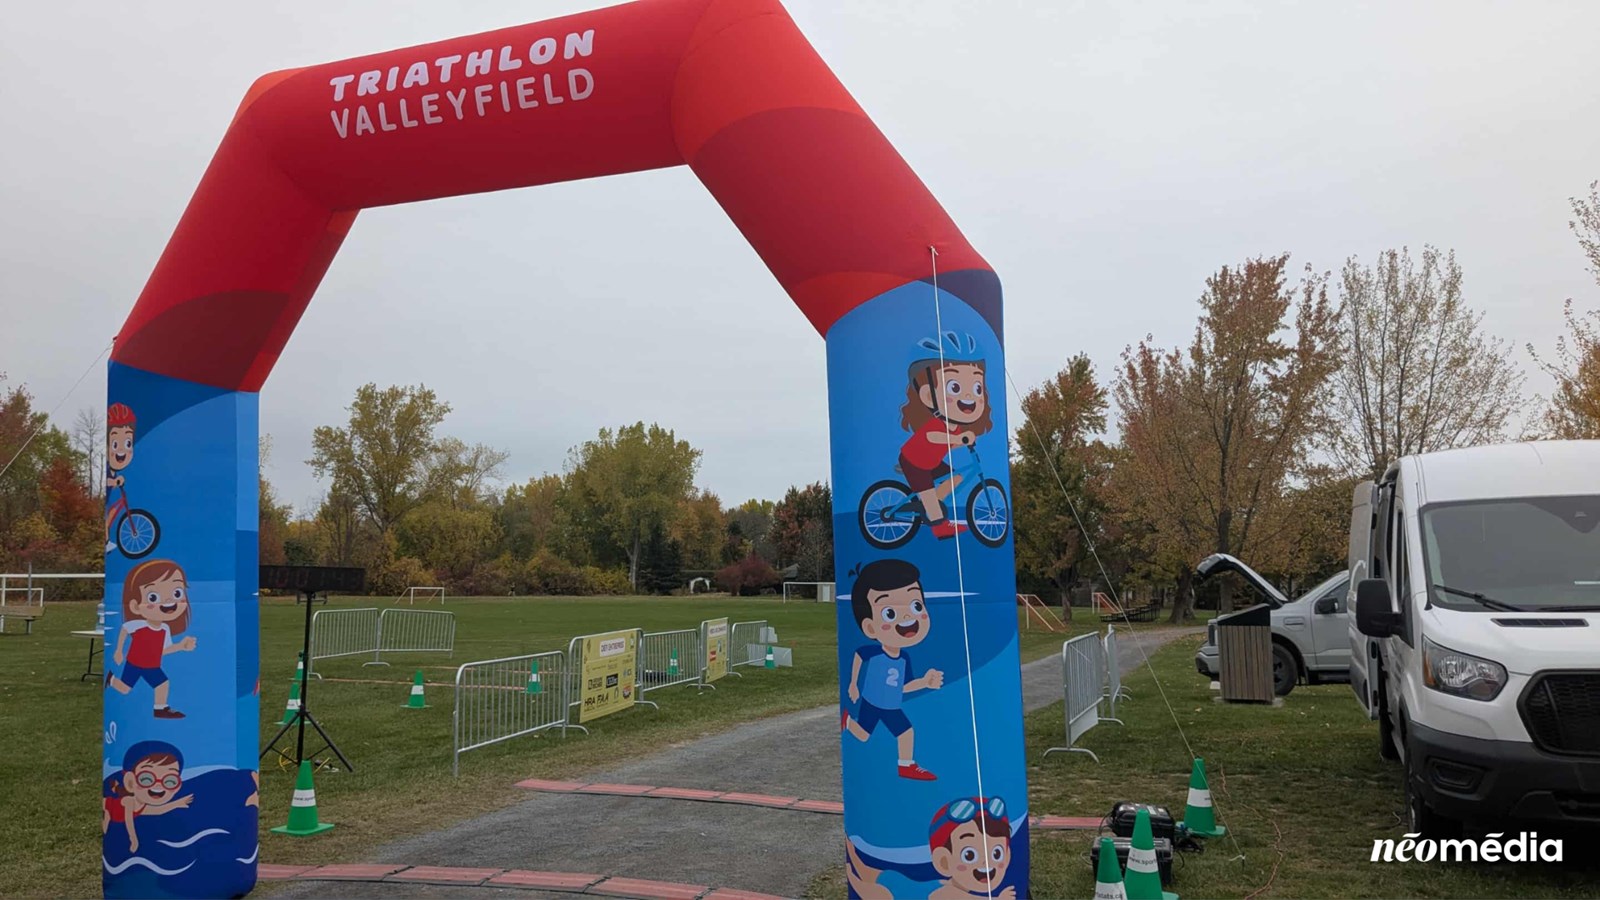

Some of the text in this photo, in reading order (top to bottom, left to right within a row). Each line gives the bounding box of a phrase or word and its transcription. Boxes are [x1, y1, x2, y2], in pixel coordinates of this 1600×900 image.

[329, 29, 595, 102] TRIATHLON
[330, 68, 595, 139] VALLEYFIELD
[887, 668, 900, 686] 2
